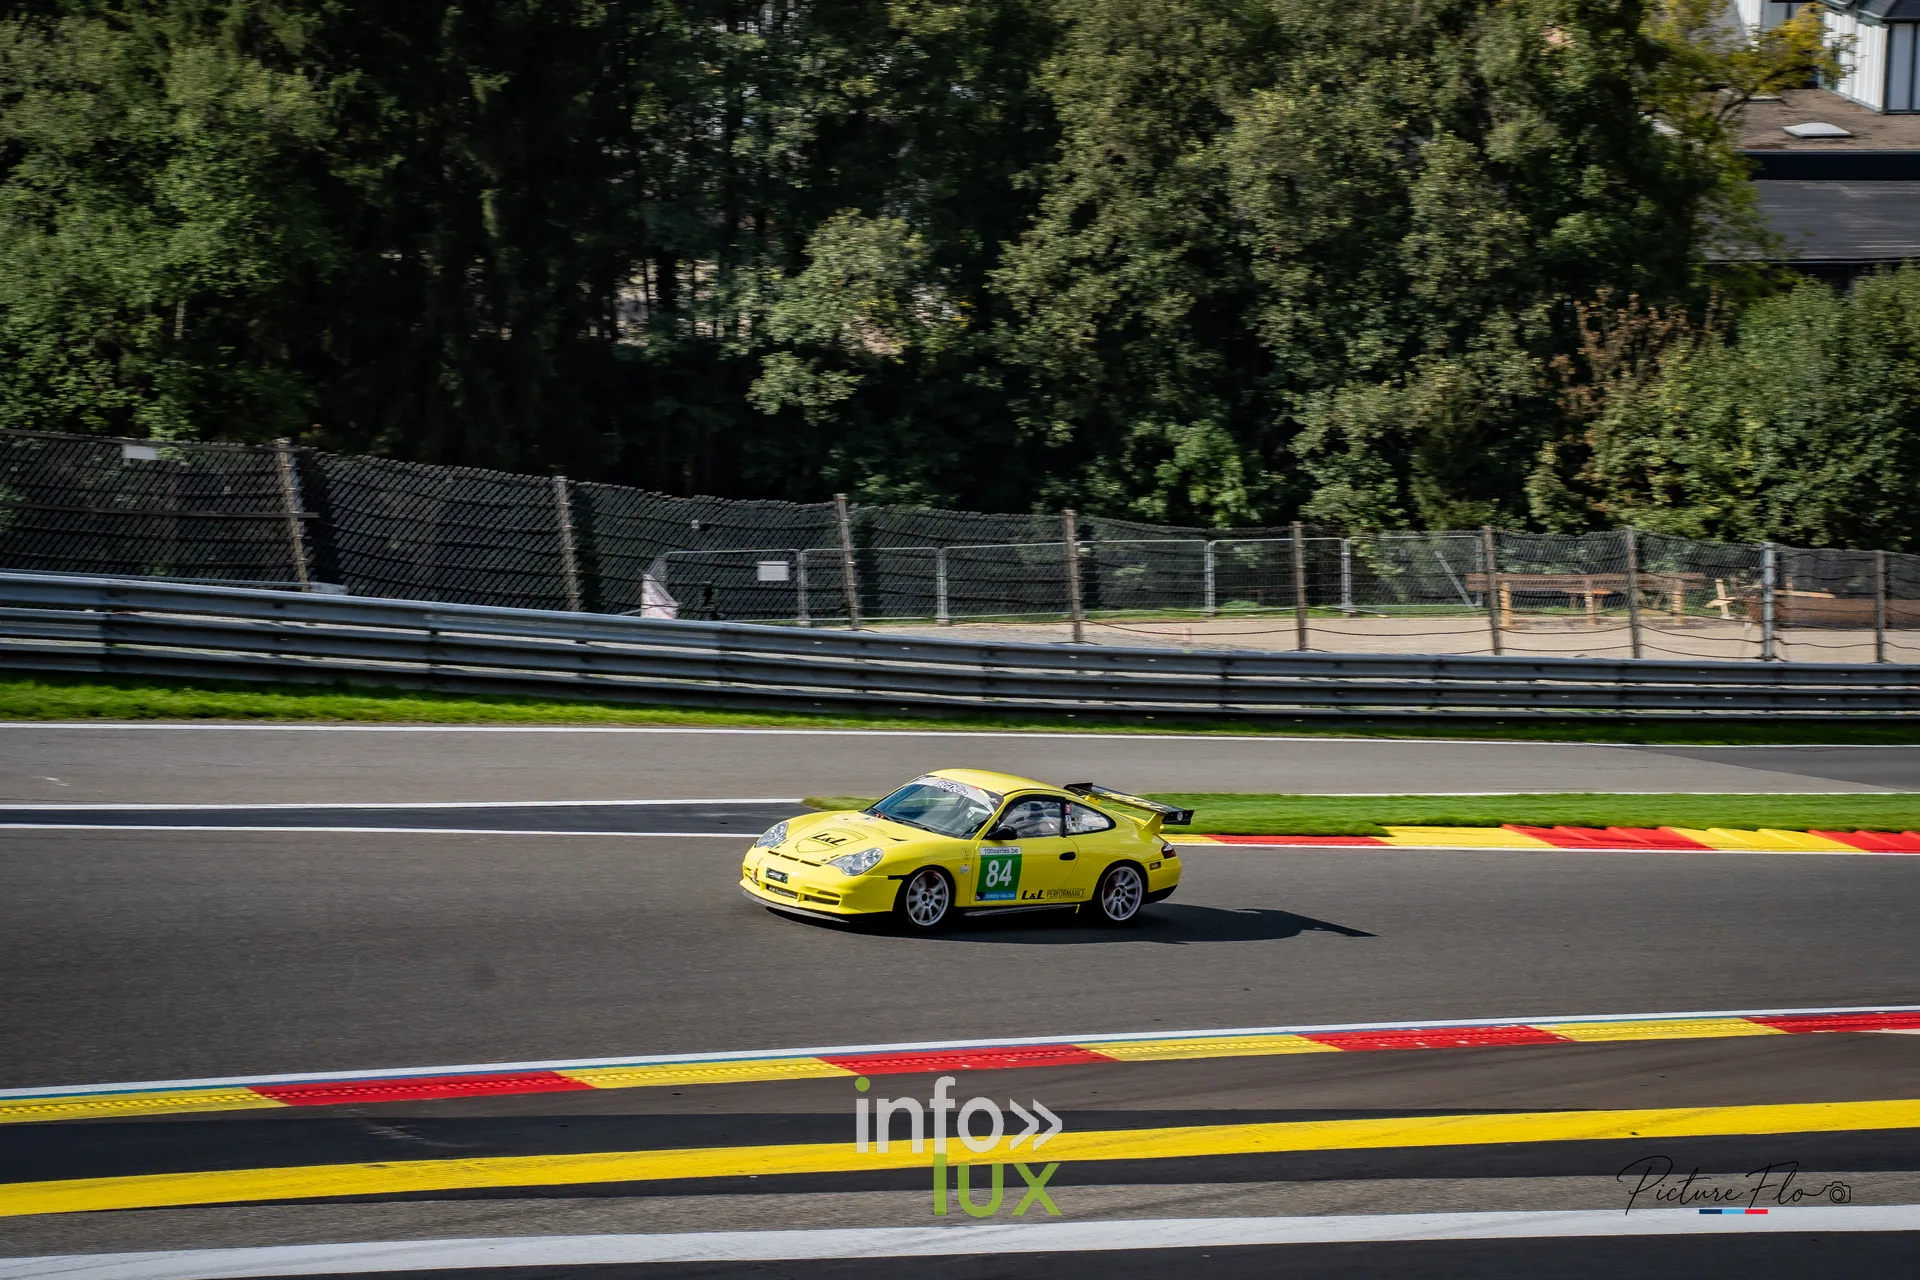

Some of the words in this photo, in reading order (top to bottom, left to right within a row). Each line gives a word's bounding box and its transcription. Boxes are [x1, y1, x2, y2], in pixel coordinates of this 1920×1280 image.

[811, 833, 848, 846] L&L
[986, 859, 1012, 888] 84
[1021, 889, 1045, 900] L&L
[1047, 888, 1086, 899] PERFORMANCE
